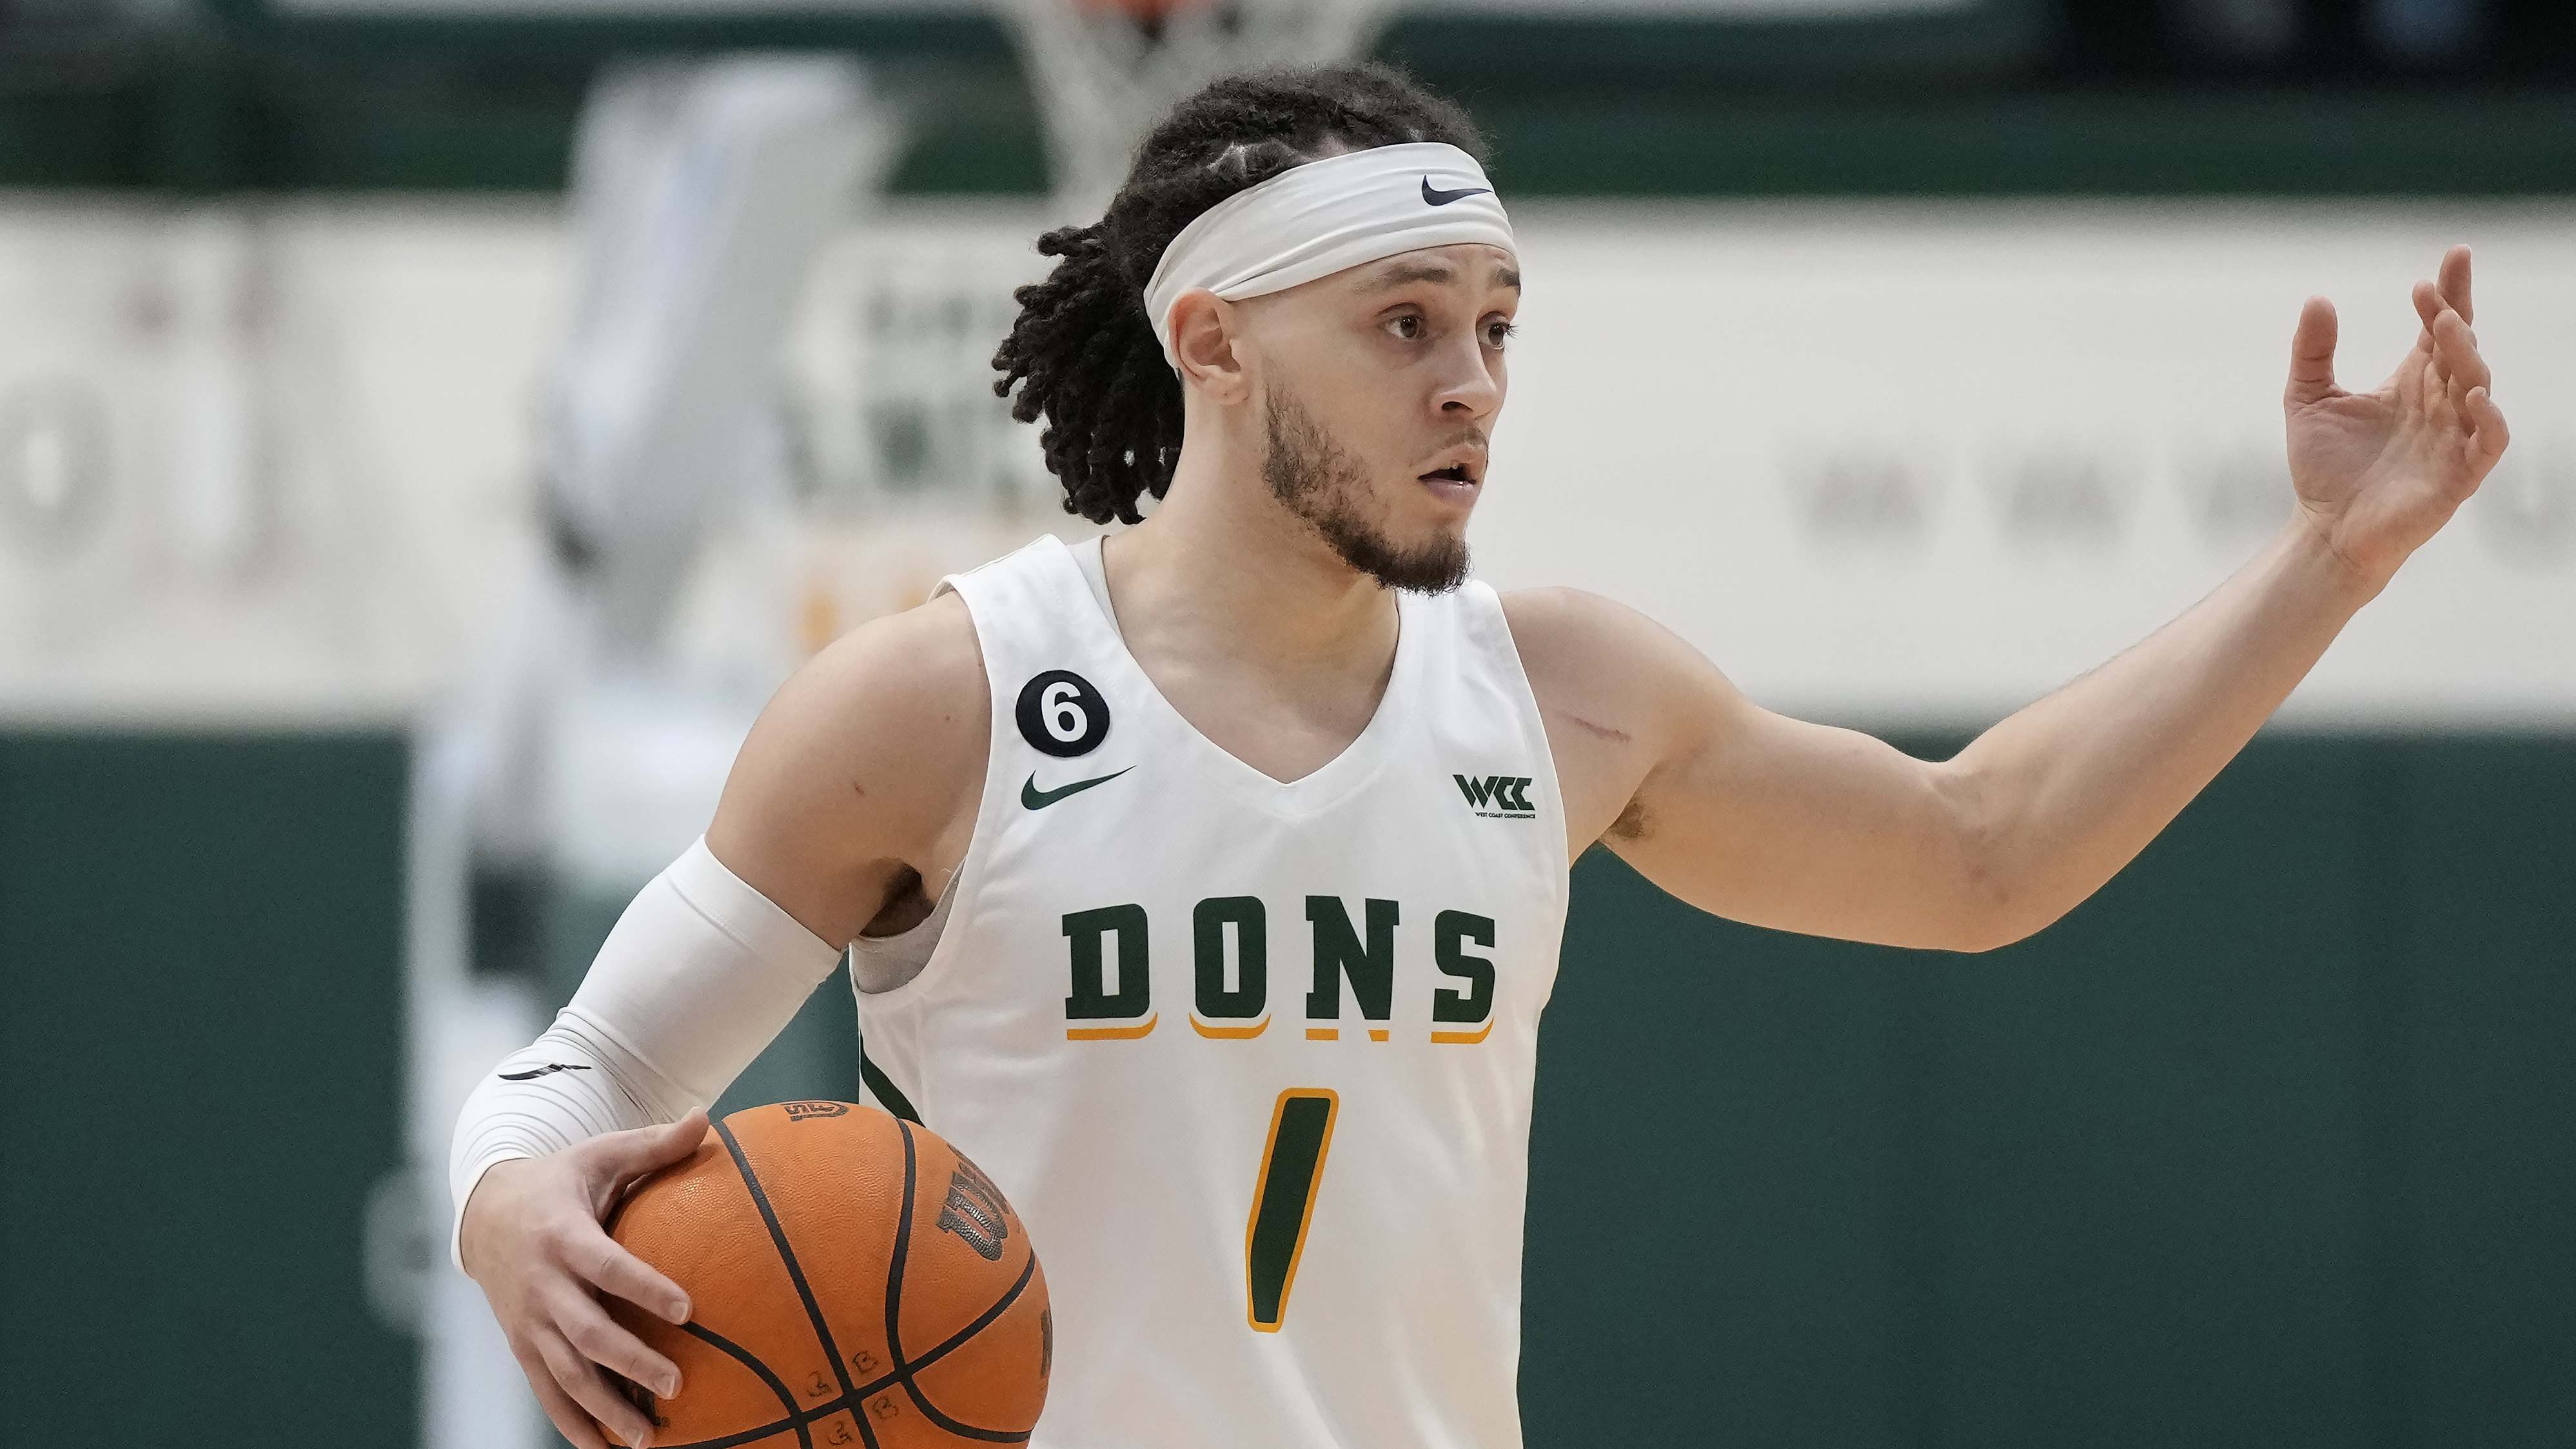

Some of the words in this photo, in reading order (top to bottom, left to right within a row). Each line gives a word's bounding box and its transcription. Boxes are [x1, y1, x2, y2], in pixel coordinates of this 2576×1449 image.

[1041, 681, 1088, 742] 6
[1452, 774, 1535, 811] WCC
[1062, 895, 1496, 1044] DONS
[1244, 1087, 1340, 1333] 1
